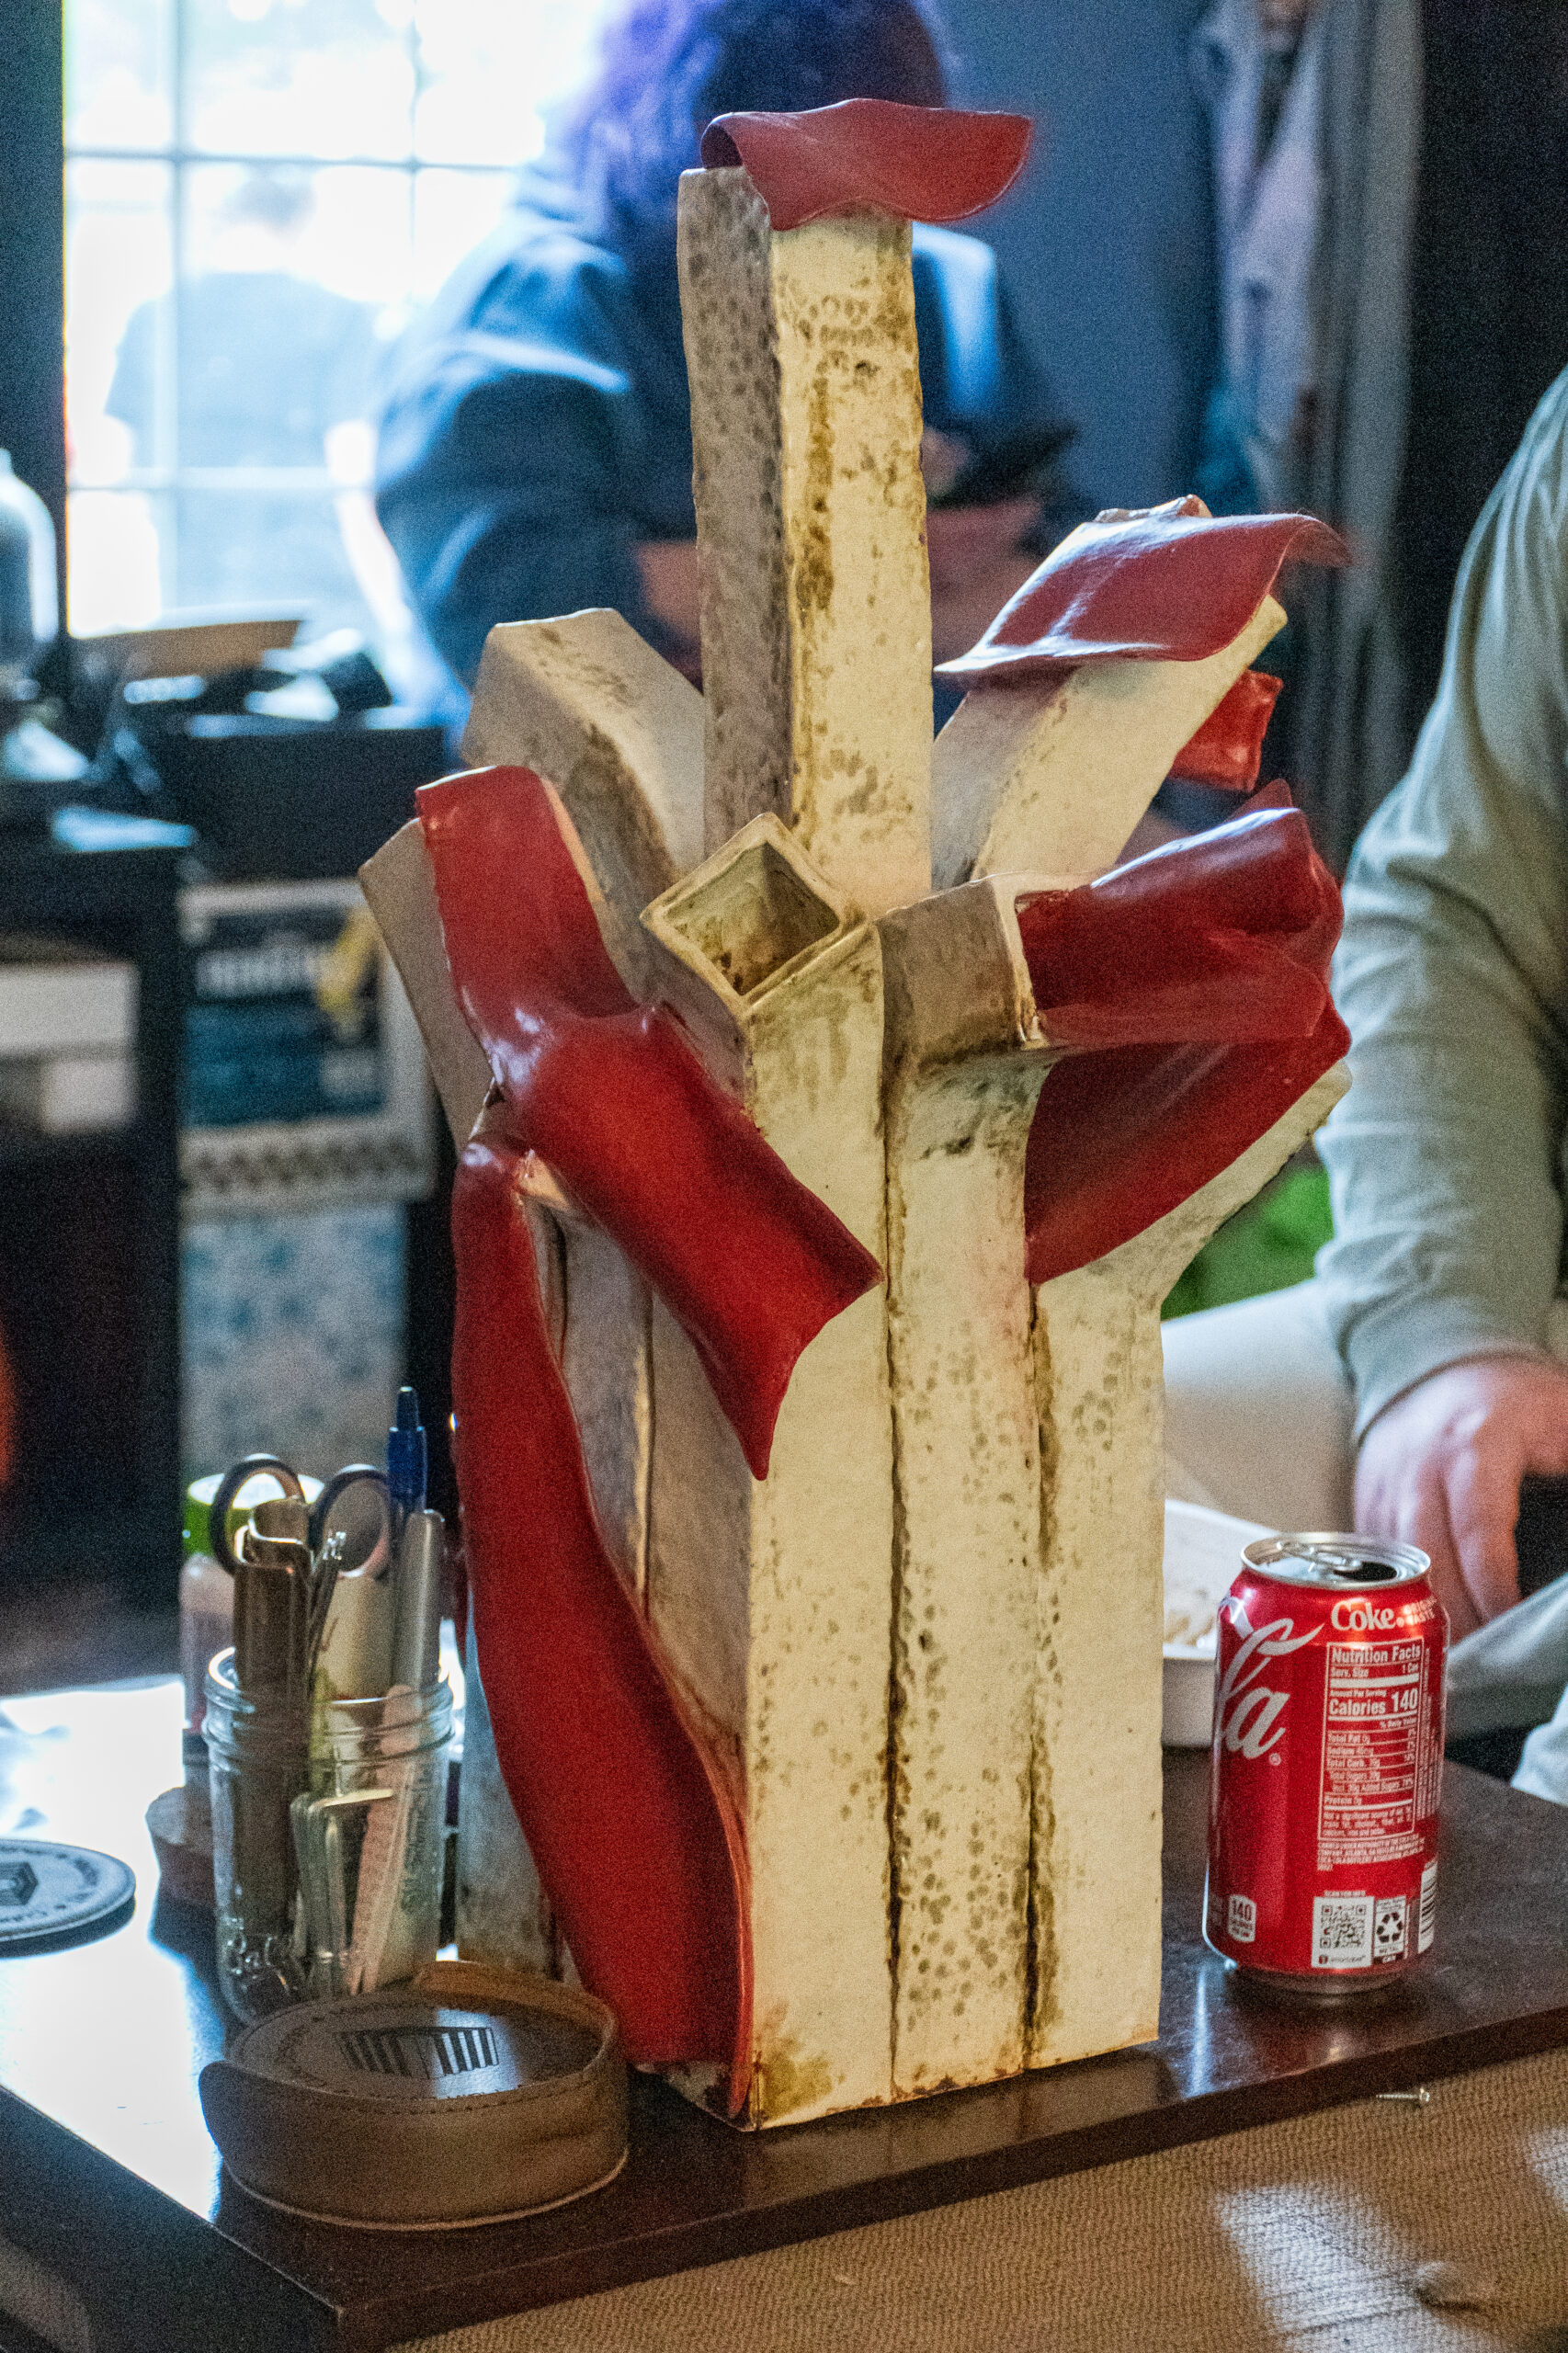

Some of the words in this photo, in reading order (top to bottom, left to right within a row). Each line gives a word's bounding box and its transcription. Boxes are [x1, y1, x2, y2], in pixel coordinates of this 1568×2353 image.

[1332, 1645, 1388, 1663] Nutrition
[1392, 1643, 1421, 1661] Facts
[1353, 1667, 1369, 1677] Size
[1329, 1698, 1386, 1715] Calories
[1391, 1688, 1418, 1712] 140
[1232, 1899, 1252, 1921] 140
